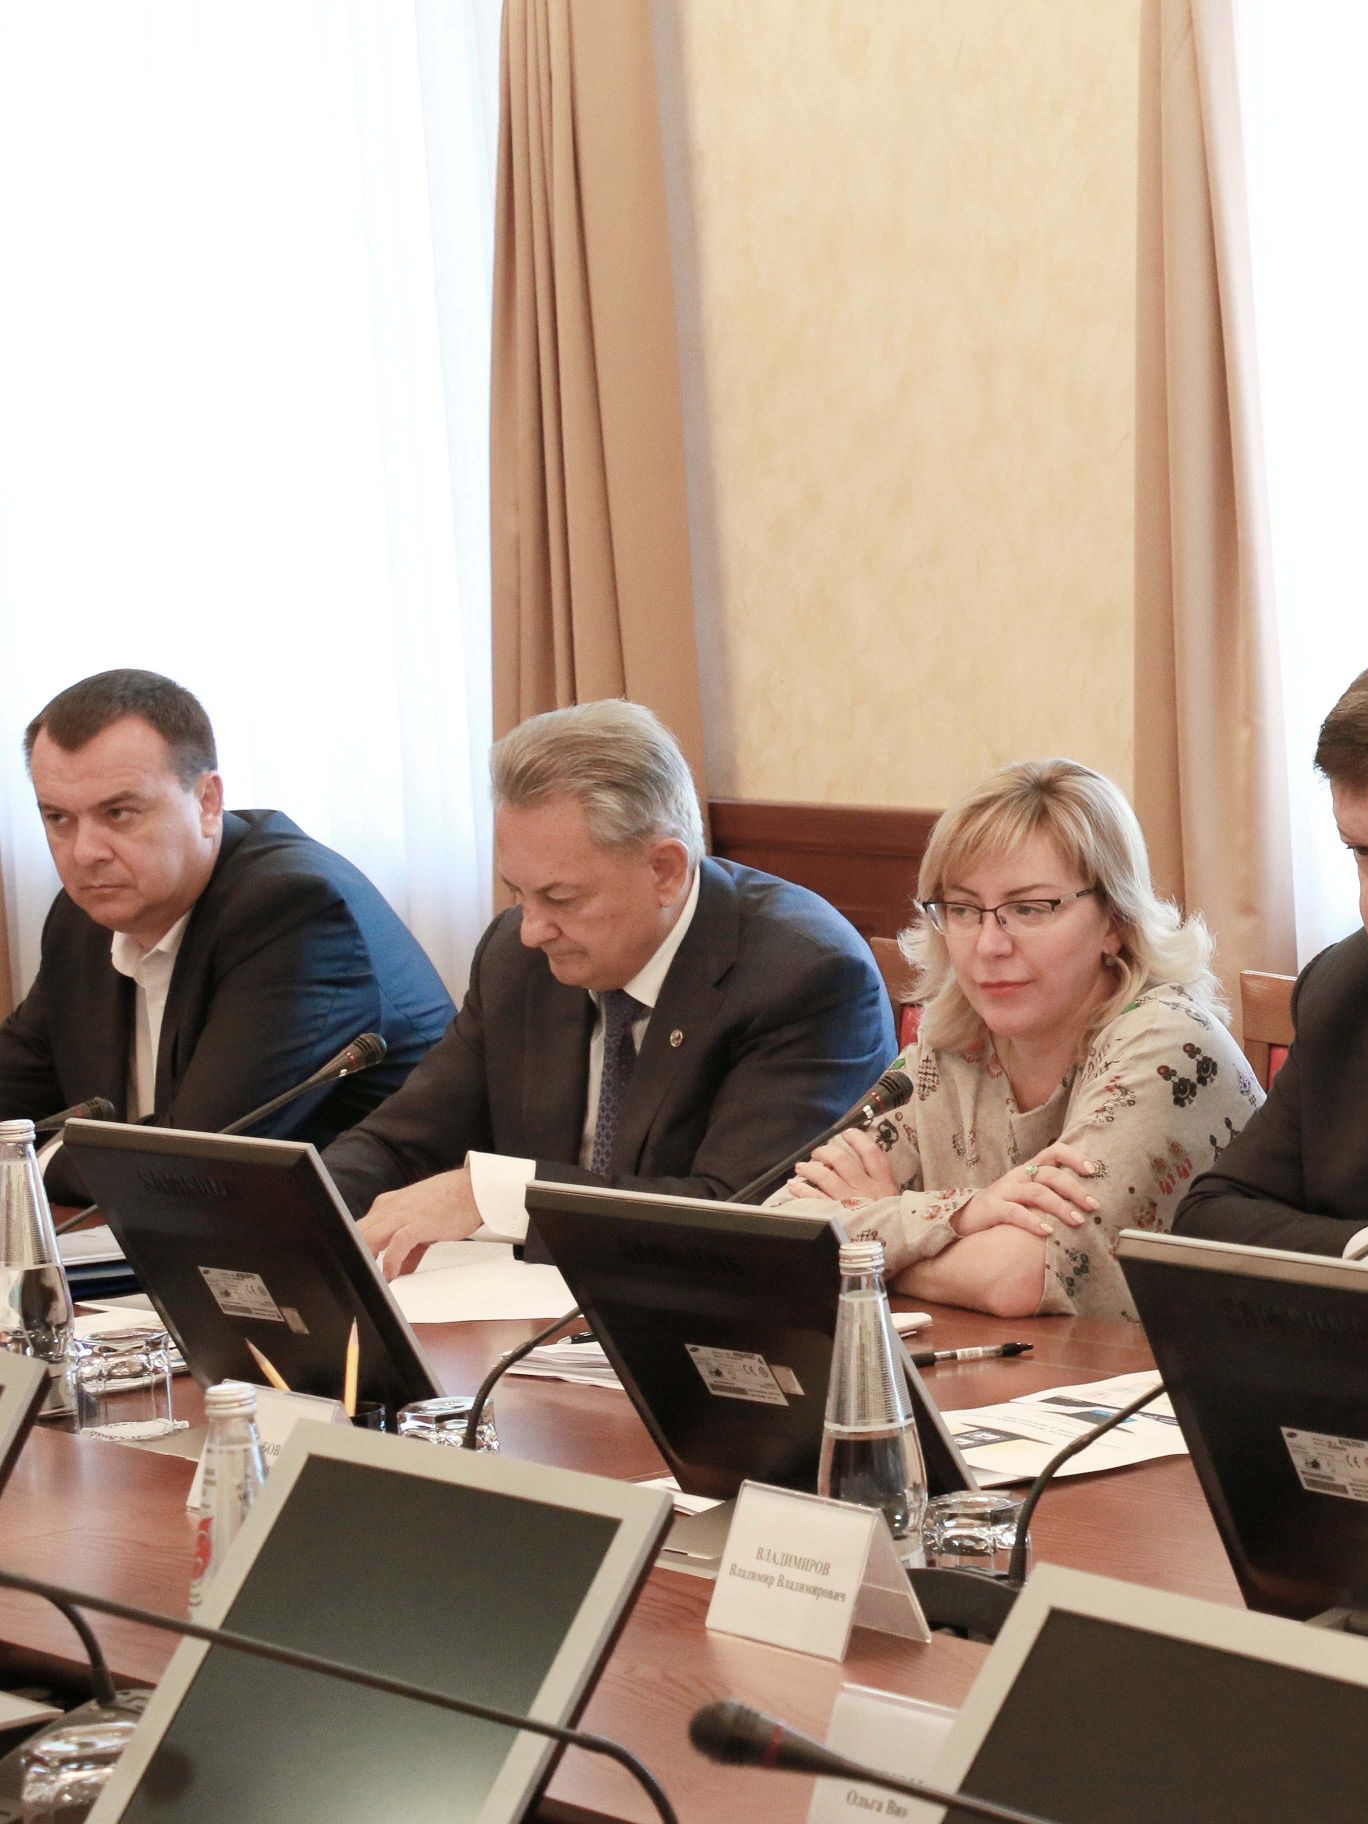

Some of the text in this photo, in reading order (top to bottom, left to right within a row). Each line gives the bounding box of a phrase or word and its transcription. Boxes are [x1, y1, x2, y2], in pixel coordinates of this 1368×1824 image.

[756, 1547, 831, 1576] ВЛАДИМИРОВ
[728, 1563, 846, 1603] Владимир Владимирович
[846, 1789, 883, 1812] Ольга
